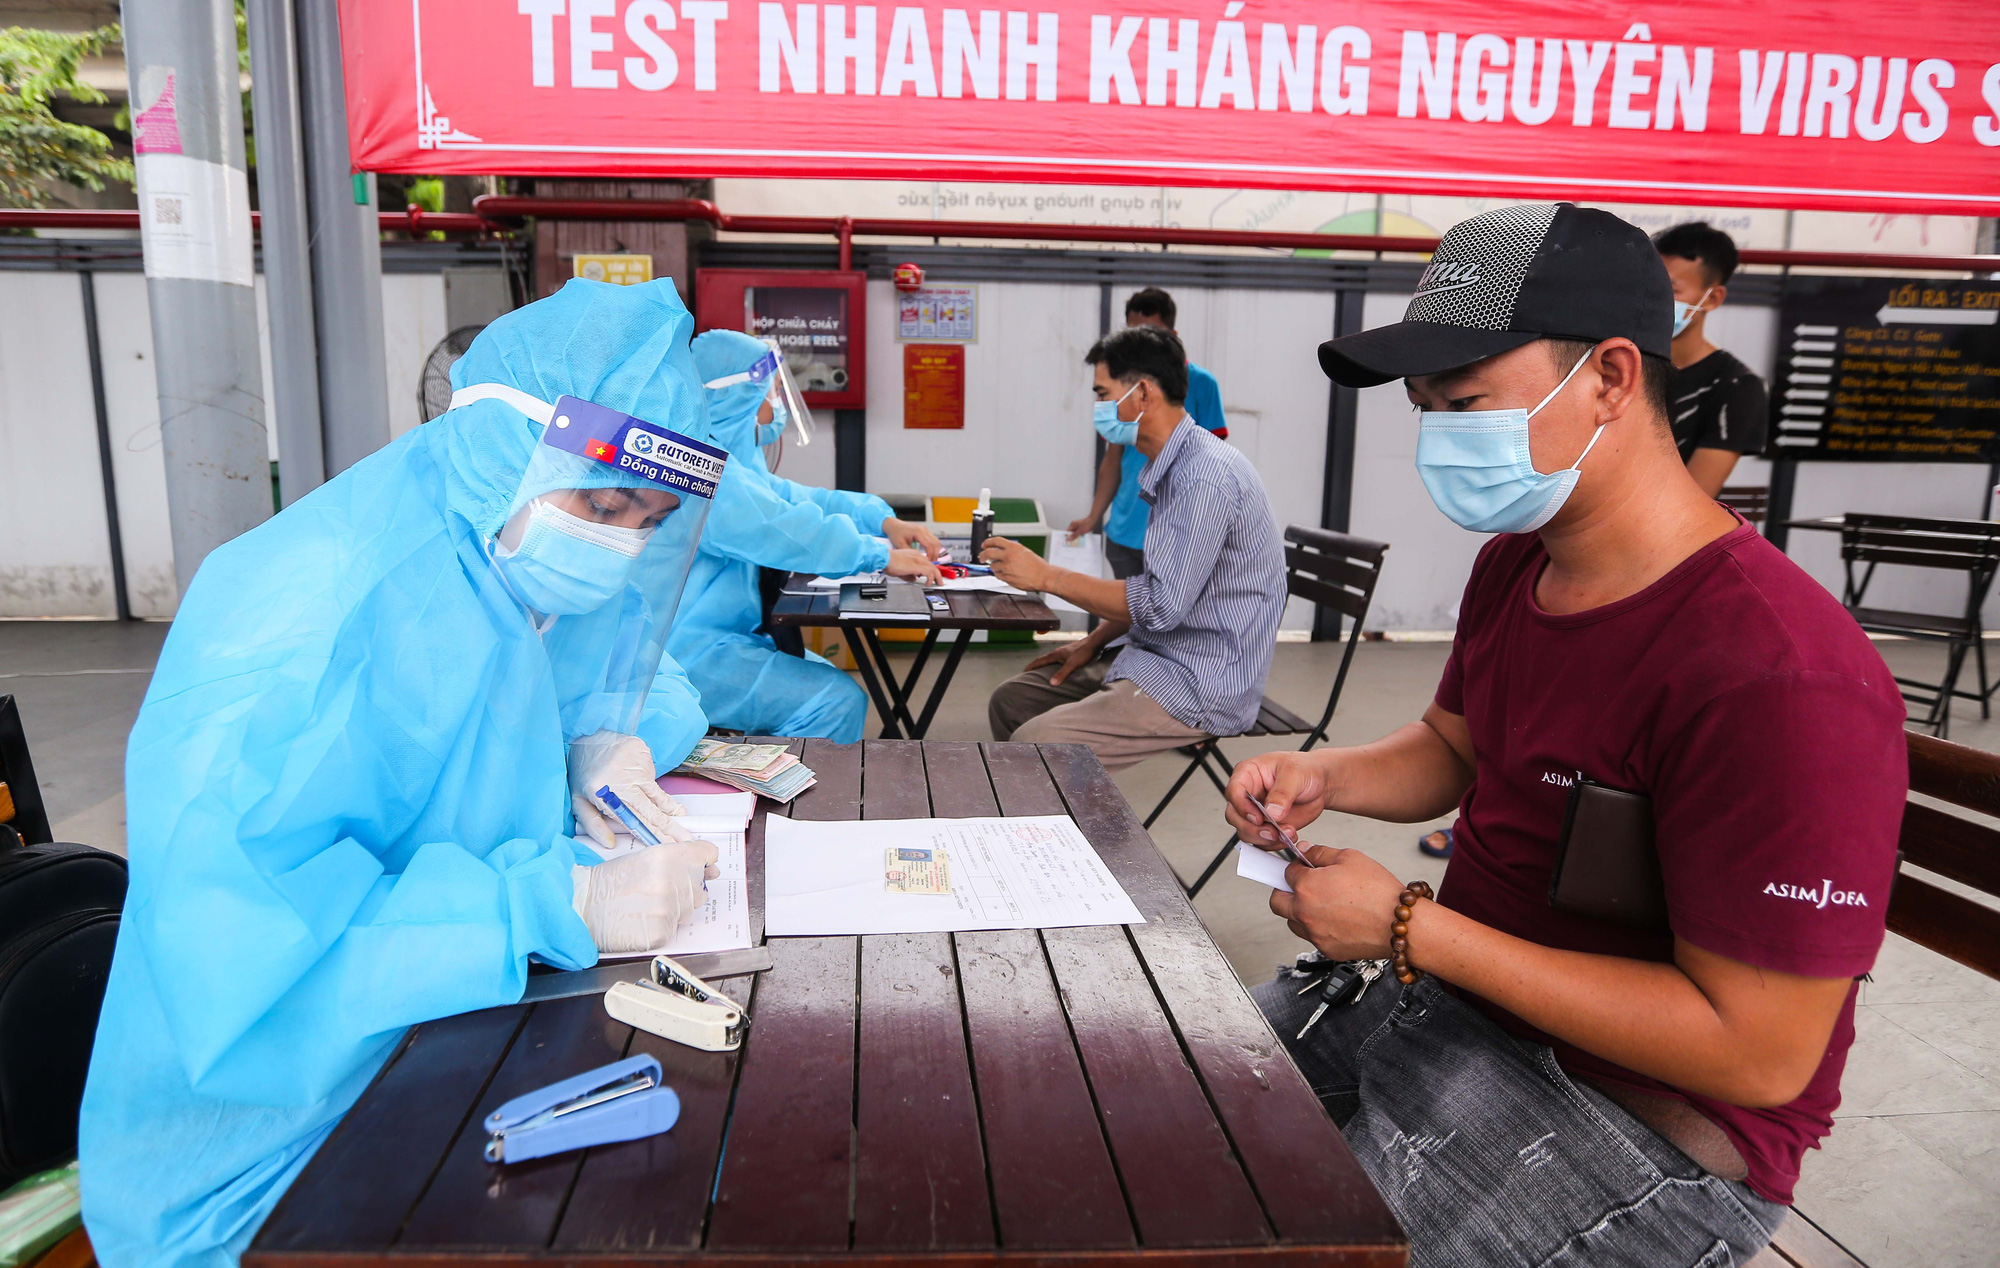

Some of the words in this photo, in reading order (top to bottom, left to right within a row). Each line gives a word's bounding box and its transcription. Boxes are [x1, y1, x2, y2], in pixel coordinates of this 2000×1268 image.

[518, 0, 729, 92] TEST
[759, 2, 1060, 102] NHANH
[1089, 1, 1372, 116] KHÁNG
[1398, 23, 1714, 132] NGUYÊN
[1739, 50, 1955, 144] VIRUS
[1888, 283, 1920, 307] LỐI
[1921, 289, 1949, 307] RA
[1962, 290, 2000, 309] EXIT
[752, 316, 775, 330] HỘP
[809, 317, 840, 329] CHÁY
[779, 335, 810, 347] HOSE
[813, 335, 840, 347] REEL
[657, 443, 712, 471] AUTORETS
[619, 454, 658, 480] Đồng
[661, 468, 690, 489] hành
[691, 481, 713, 498] chống
